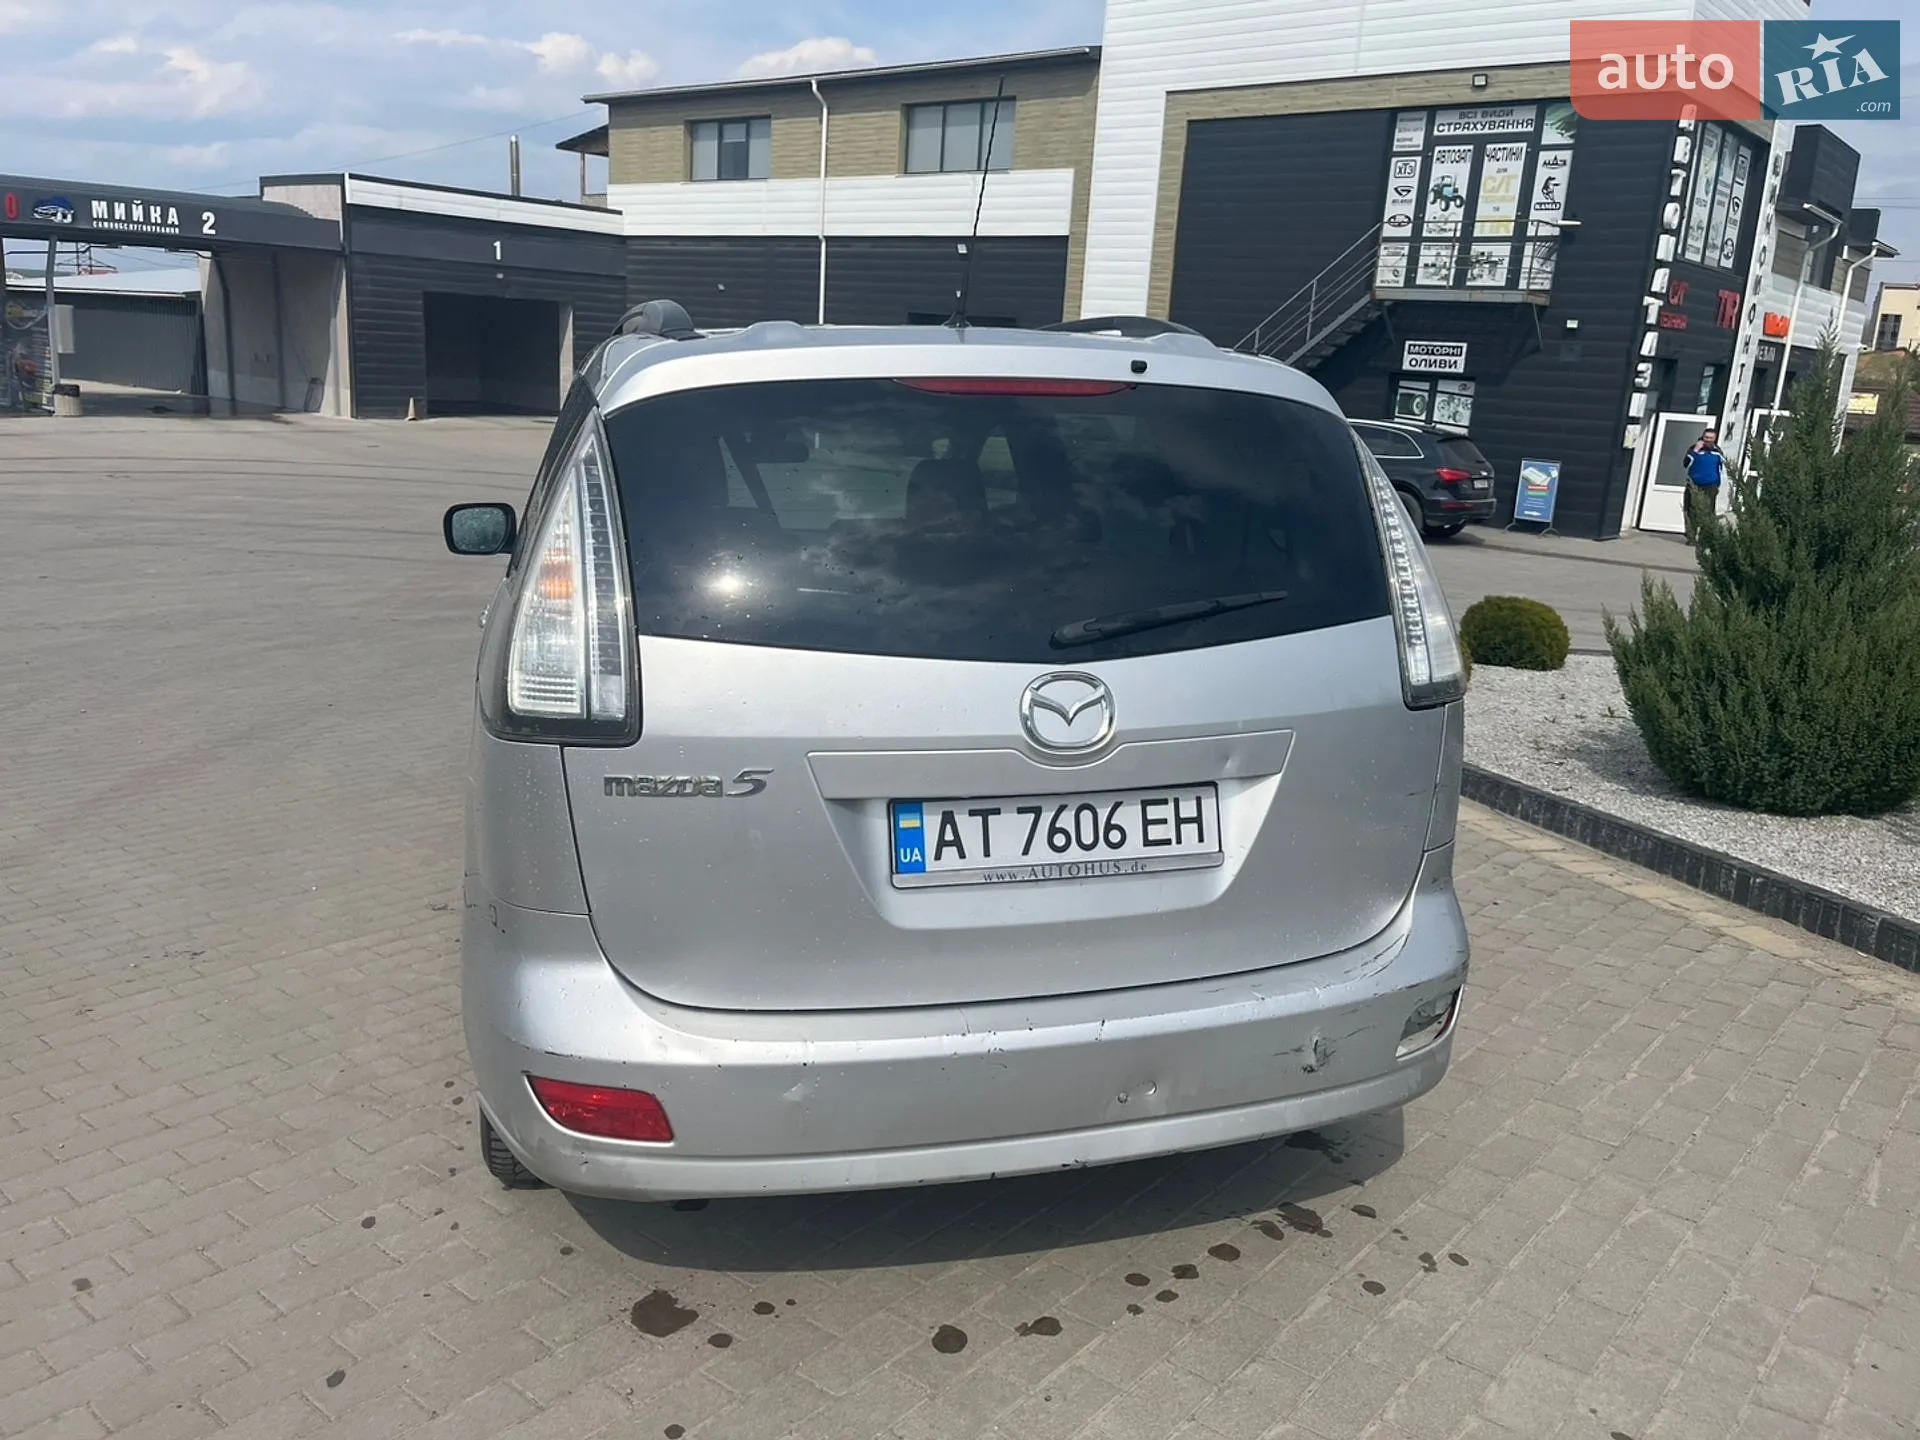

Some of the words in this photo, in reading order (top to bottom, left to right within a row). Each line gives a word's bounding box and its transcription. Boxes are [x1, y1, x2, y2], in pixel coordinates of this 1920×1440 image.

[1459, 109, 1478, 120] ВСІ
[1436, 118, 1534, 133] СТРАХУВАННЯ
[91, 200, 180, 226] МИЙКА
[202, 211, 216, 235] 2
[493, 240, 501, 260] 1
[1409, 345, 1462, 355] МОТОРНІ
[1409, 358, 1458, 369] ОЛИВИ
[603, 773, 724, 798] mazda
[933, 807, 1001, 861] AT
[1016, 800, 1128, 856] 7606
[1139, 795, 1205, 848] EH
[900, 847, 922, 863] UA
